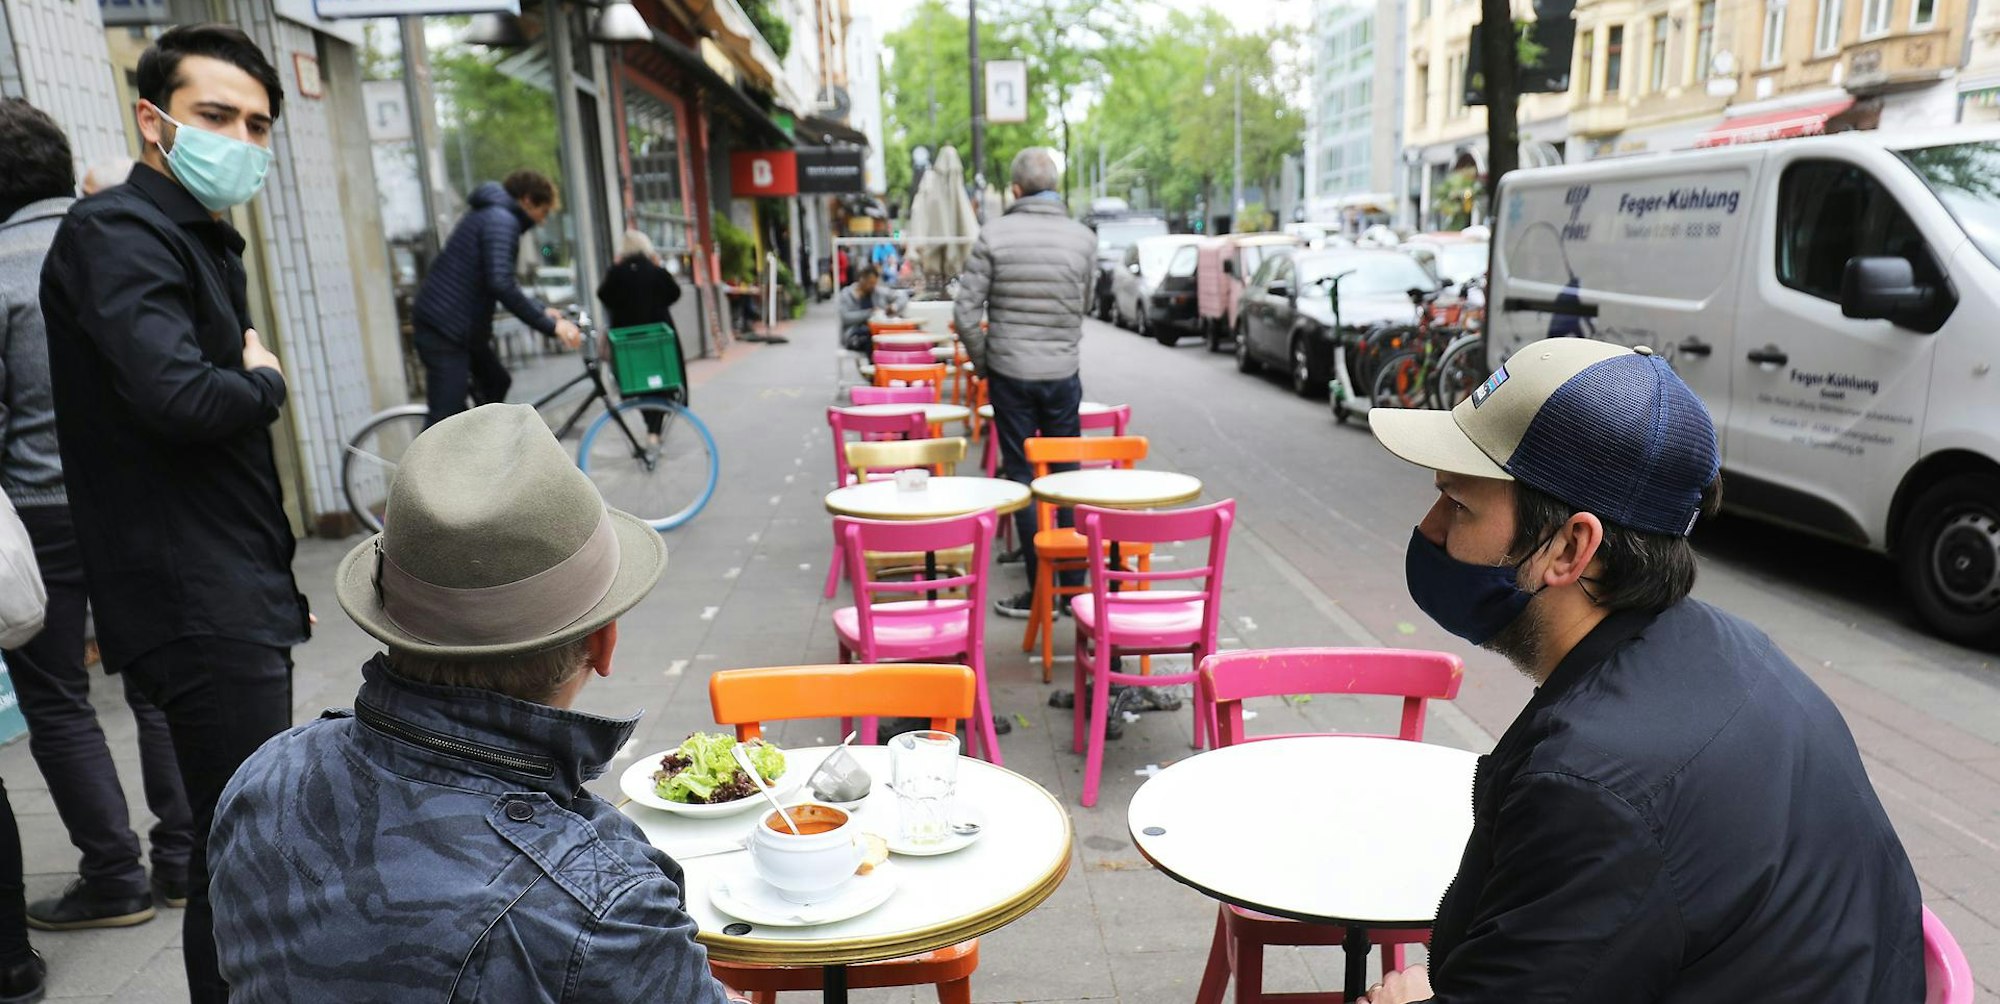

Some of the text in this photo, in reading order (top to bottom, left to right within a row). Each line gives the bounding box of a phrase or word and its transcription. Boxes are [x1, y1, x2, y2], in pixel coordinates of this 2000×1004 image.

[752, 158, 774, 188] B
[1618, 185, 1741, 218] Feger-Kühlung
[1789, 368, 1880, 394] Feger-Kühlung
